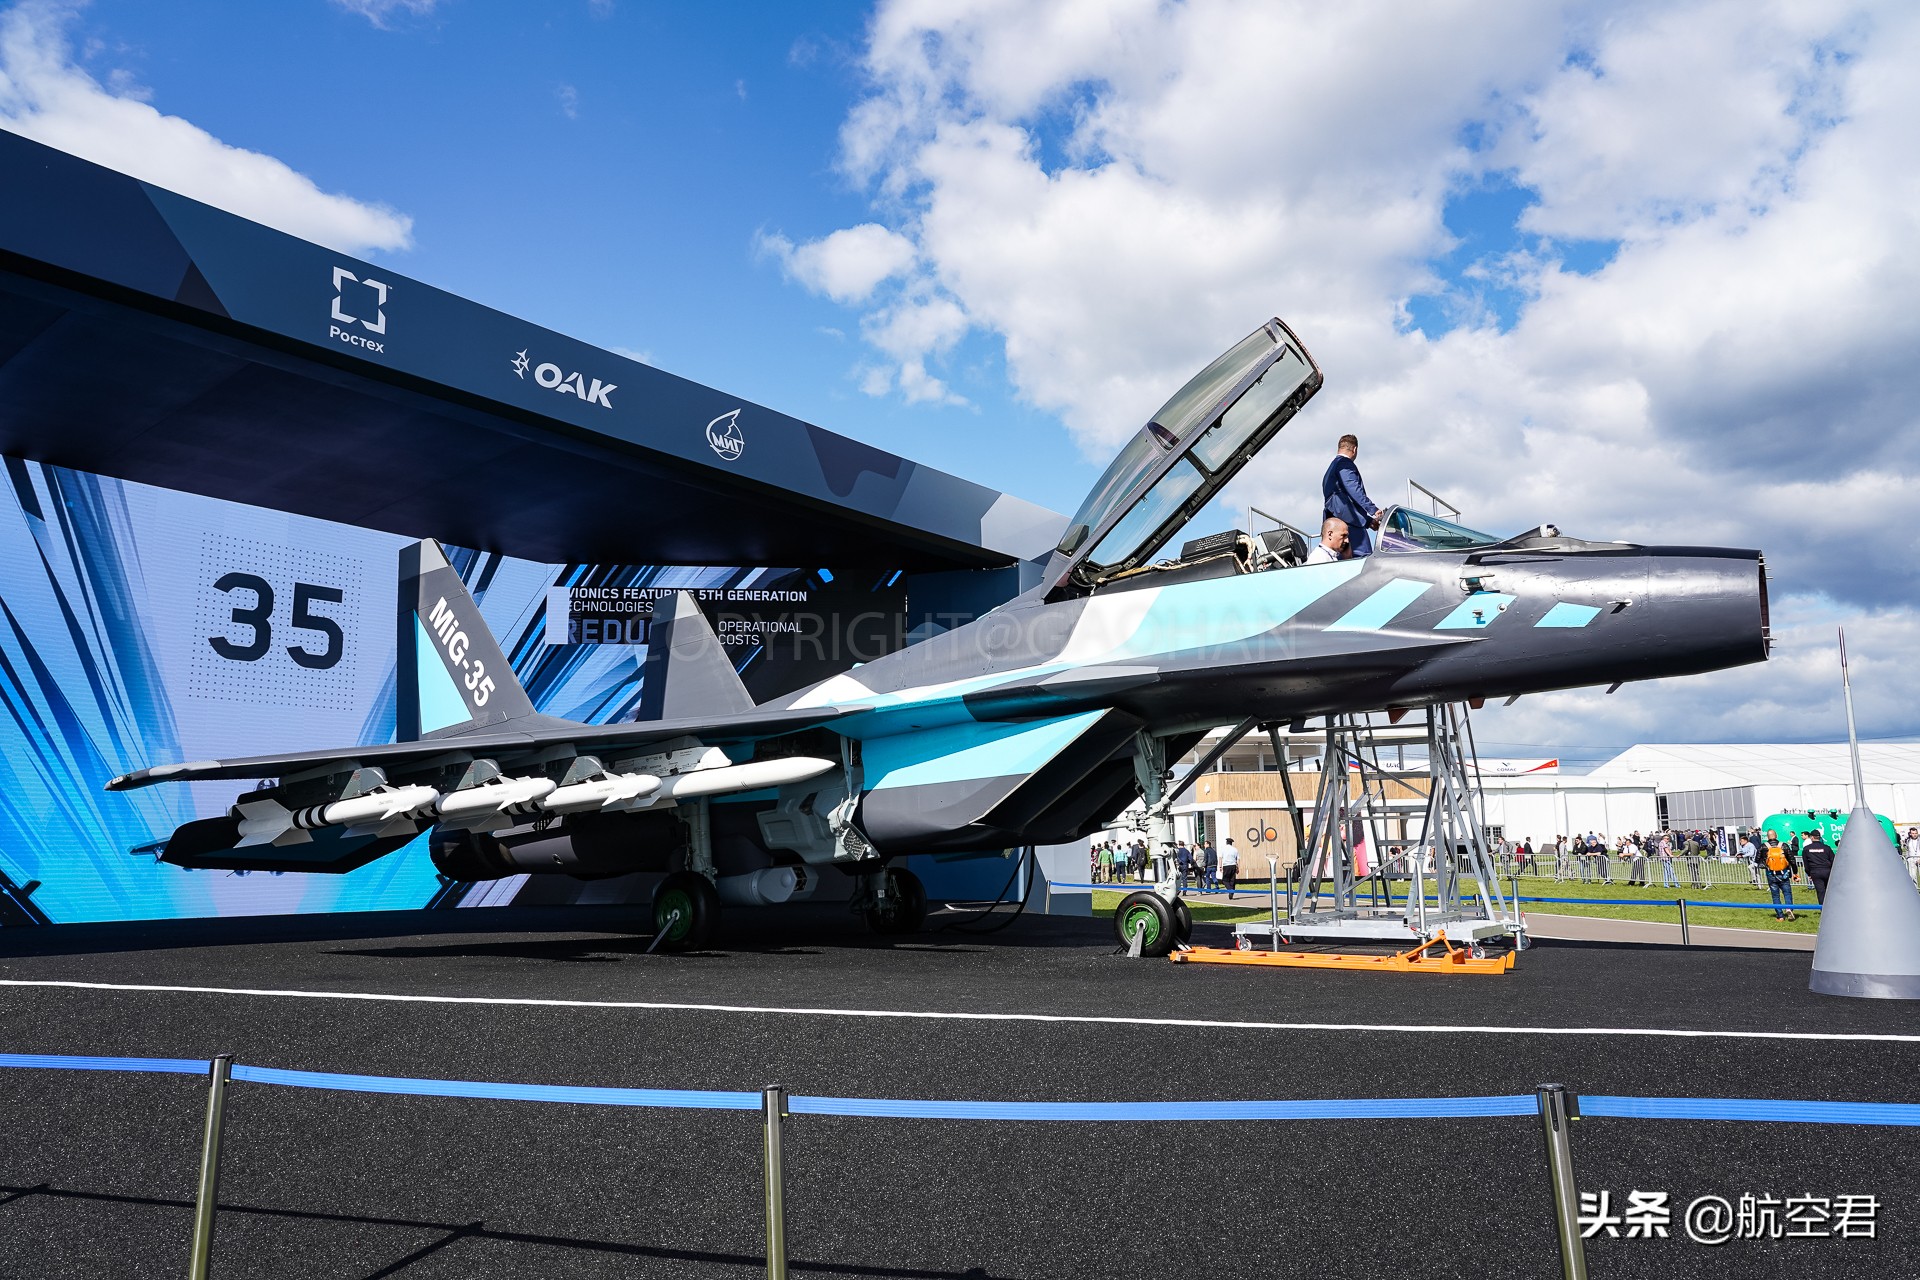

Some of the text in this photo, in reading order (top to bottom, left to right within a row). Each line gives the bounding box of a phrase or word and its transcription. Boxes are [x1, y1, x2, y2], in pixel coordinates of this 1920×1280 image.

[329, 325, 385, 354] Ростех
[569, 587, 807, 602] VIONICS FEATUR 5TH GENERATION
[569, 600, 654, 613] CHNOLOGIES
[208, 572, 344, 670] 35
[568, 618, 652, 644] REDU
[718, 621, 803, 633] OPERATIONAL
[428, 596, 496, 707] MiG-35
[719, 634, 760, 646] COSTS
[1246, 818, 1278, 848] glo
